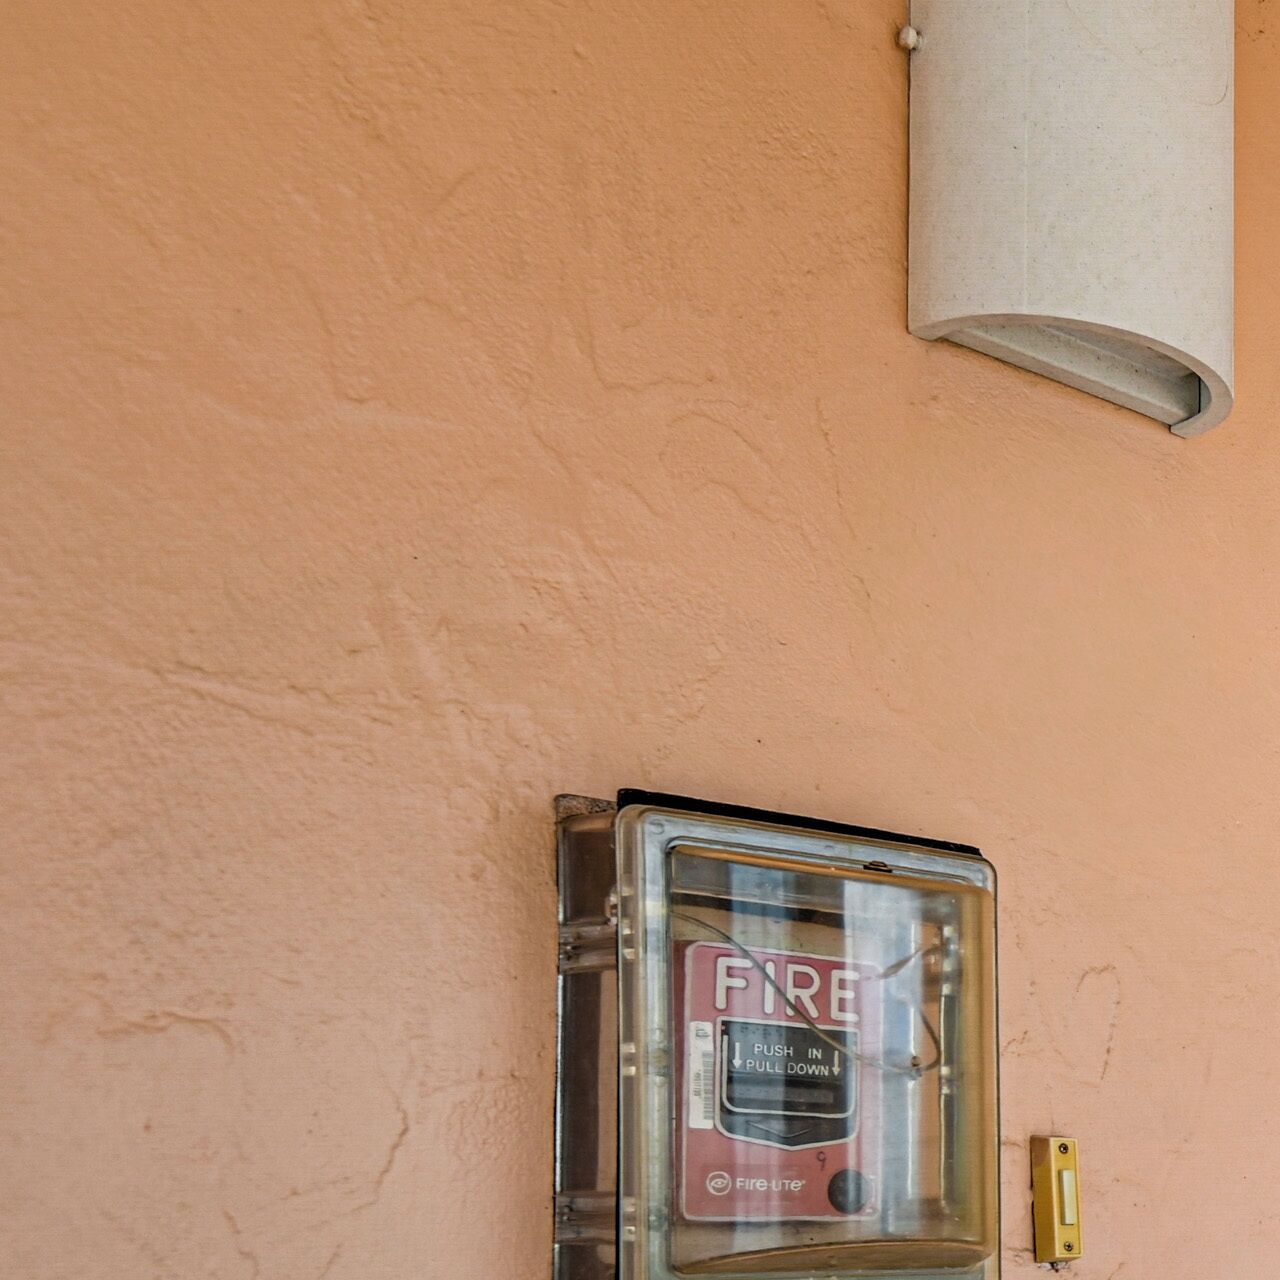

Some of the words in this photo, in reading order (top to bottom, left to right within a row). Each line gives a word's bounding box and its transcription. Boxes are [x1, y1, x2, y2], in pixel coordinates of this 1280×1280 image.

[714, 956, 860, 1022] FIRE
[753, 1043, 793, 1057] PUSH
[807, 1048, 822, 1060] IN
[746, 1059, 782, 1073] PULL
[787, 1063, 829, 1076] DOWN
